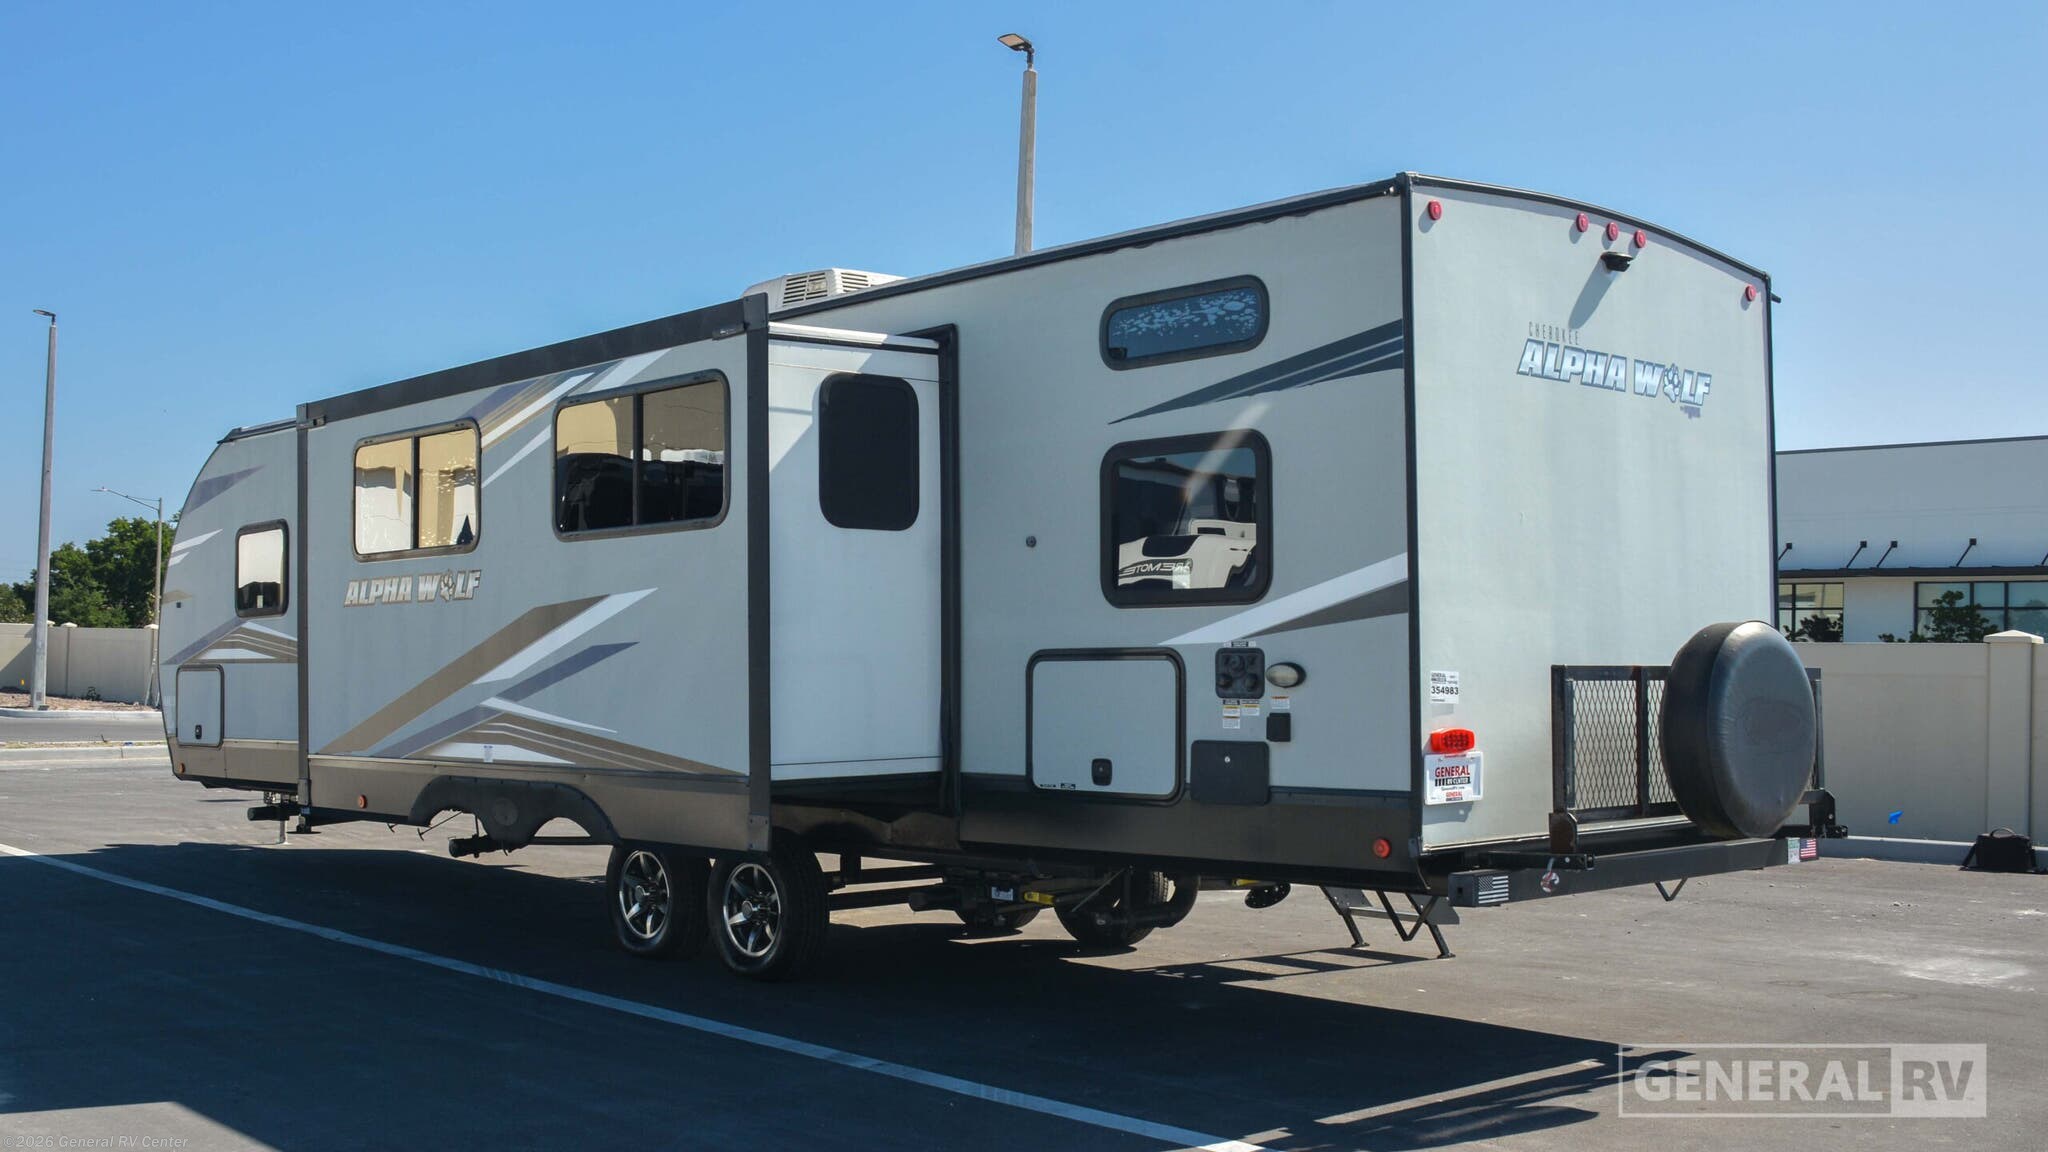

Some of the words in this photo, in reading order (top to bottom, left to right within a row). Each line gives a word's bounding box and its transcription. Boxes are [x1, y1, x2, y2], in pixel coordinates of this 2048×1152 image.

[1516, 338, 1628, 392] ALPHA
[344, 576, 413, 608] ALPHA
[1431, 686, 1459, 695] 354983
[1435, 765, 1470, 777] GENERAL
